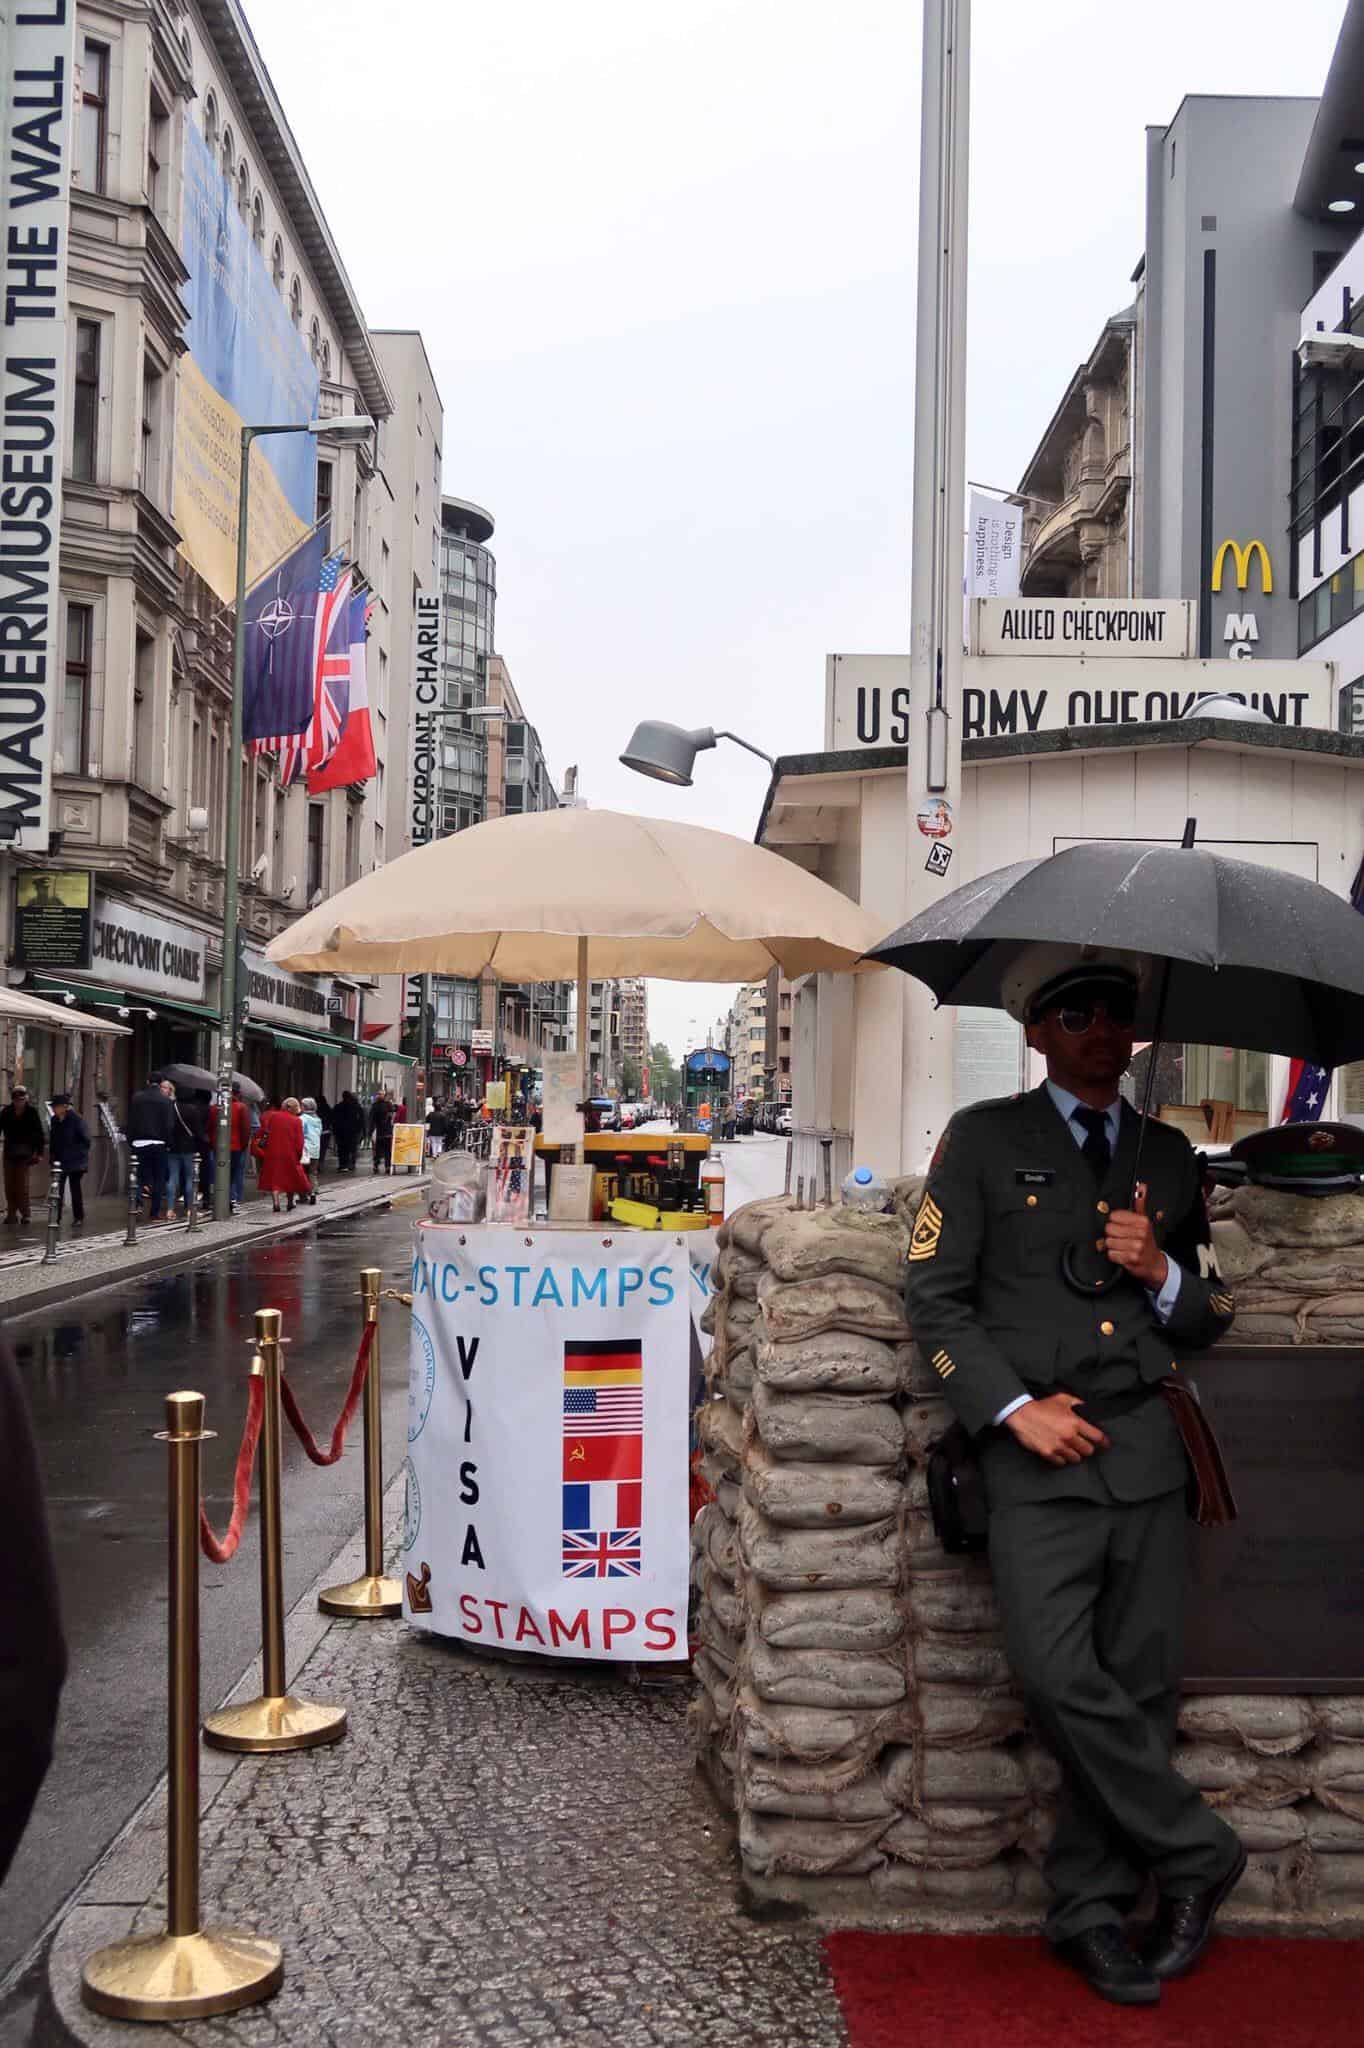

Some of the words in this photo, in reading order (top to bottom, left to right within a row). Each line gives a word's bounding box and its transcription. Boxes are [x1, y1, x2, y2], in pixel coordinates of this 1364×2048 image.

[10, 55, 64, 209] WALL
[5, 226, 58, 326] THE
[1003, 521, 1016, 560] Design
[0, 358, 56, 827] MAUERMUSEUM
[1001, 610, 1055, 641] ALLIED
[1063, 610, 1167, 642] CHECKPOINT
[415, 597, 440, 705] CHARLIE
[961, 688, 1048, 738] RMY
[93, 918, 162, 972] CHECKPOINT
[163, 941, 201, 983] CHARLIE
[456, 1336, 486, 1570] VISA
[459, 1594, 677, 1652] STAMPS
